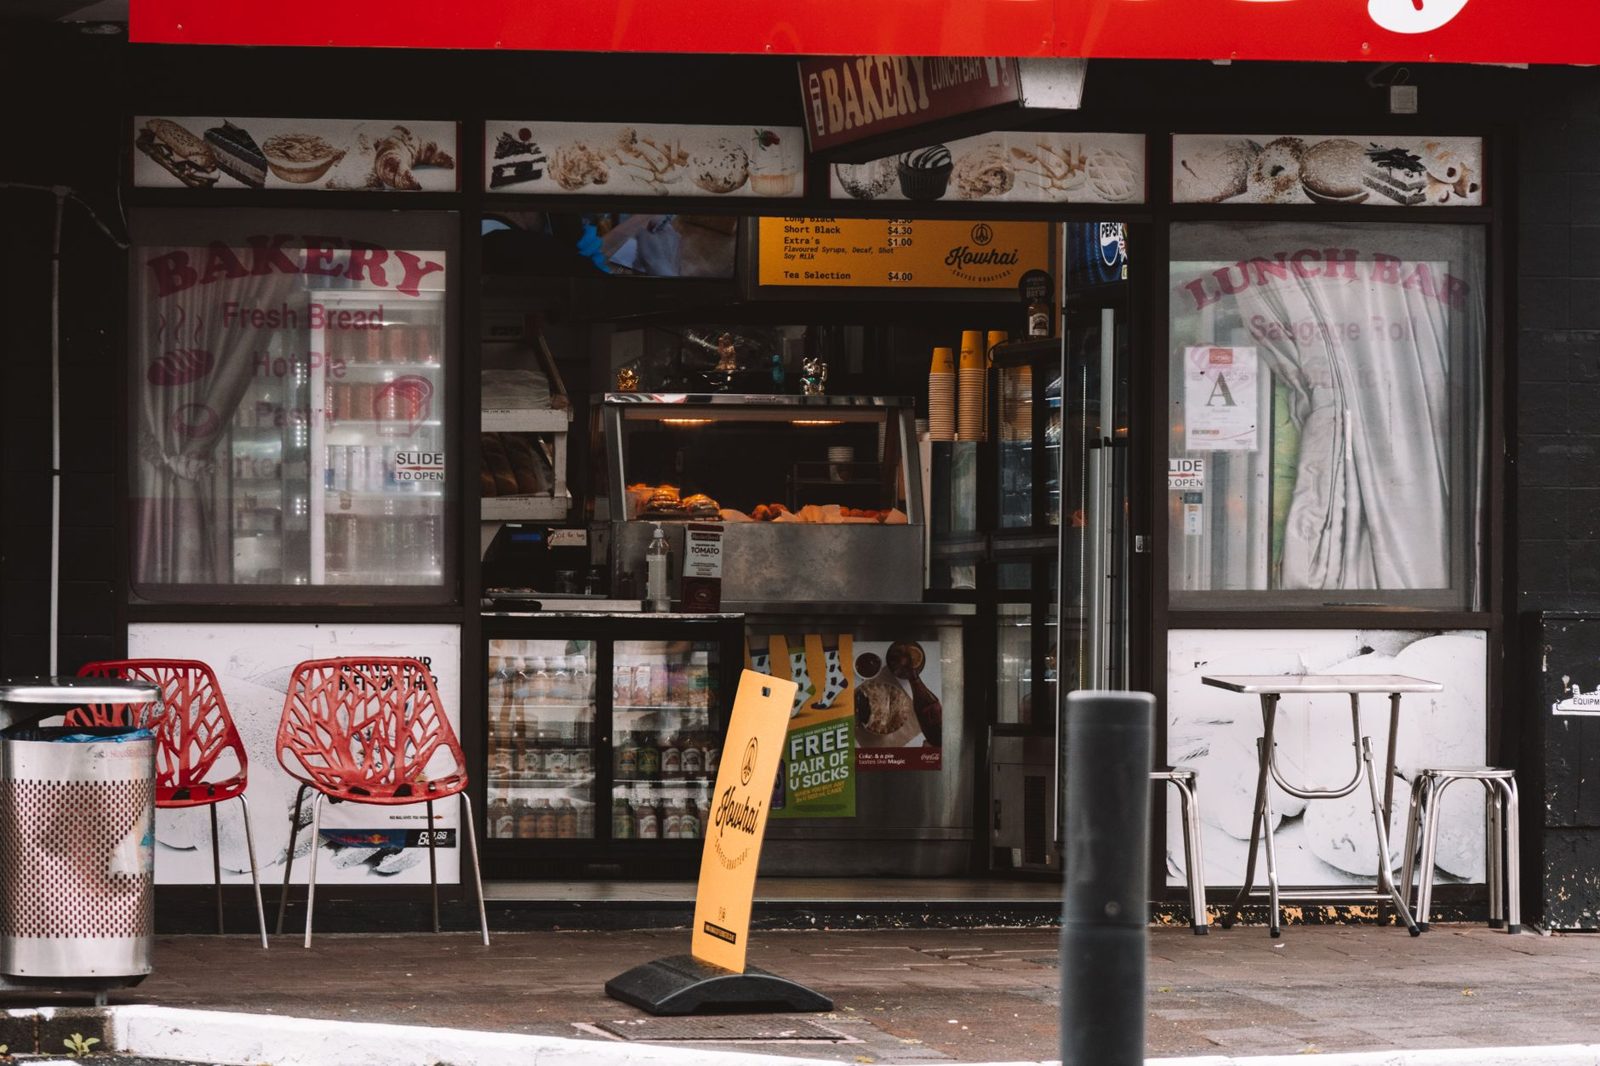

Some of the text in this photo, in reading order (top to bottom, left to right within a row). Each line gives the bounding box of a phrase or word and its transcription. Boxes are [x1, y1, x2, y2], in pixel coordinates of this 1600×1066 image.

[822, 56, 930, 134] BAKERY
[930, 57, 960, 90] LUNCH
[147, 234, 444, 298] BAKERY
[944, 246, 1018, 270] Kowhai
[1185, 248, 1359, 310] LUNCH
[1371, 252, 1469, 308] BAR
[222, 302, 384, 330] Fresh Bread
[254, 352, 346, 378] Hot Pie
[1204, 371, 1238, 407] A
[397, 453, 444, 465] SLIDE
[1168, 460, 1202, 472] LIDE
[397, 472, 444, 480] TO OPEN
[791, 727, 849, 760] FREE
[790, 750, 848, 777] PAIR OF
[802, 766, 849, 788] SOCKS
[716, 786, 762, 838] Kowhai
